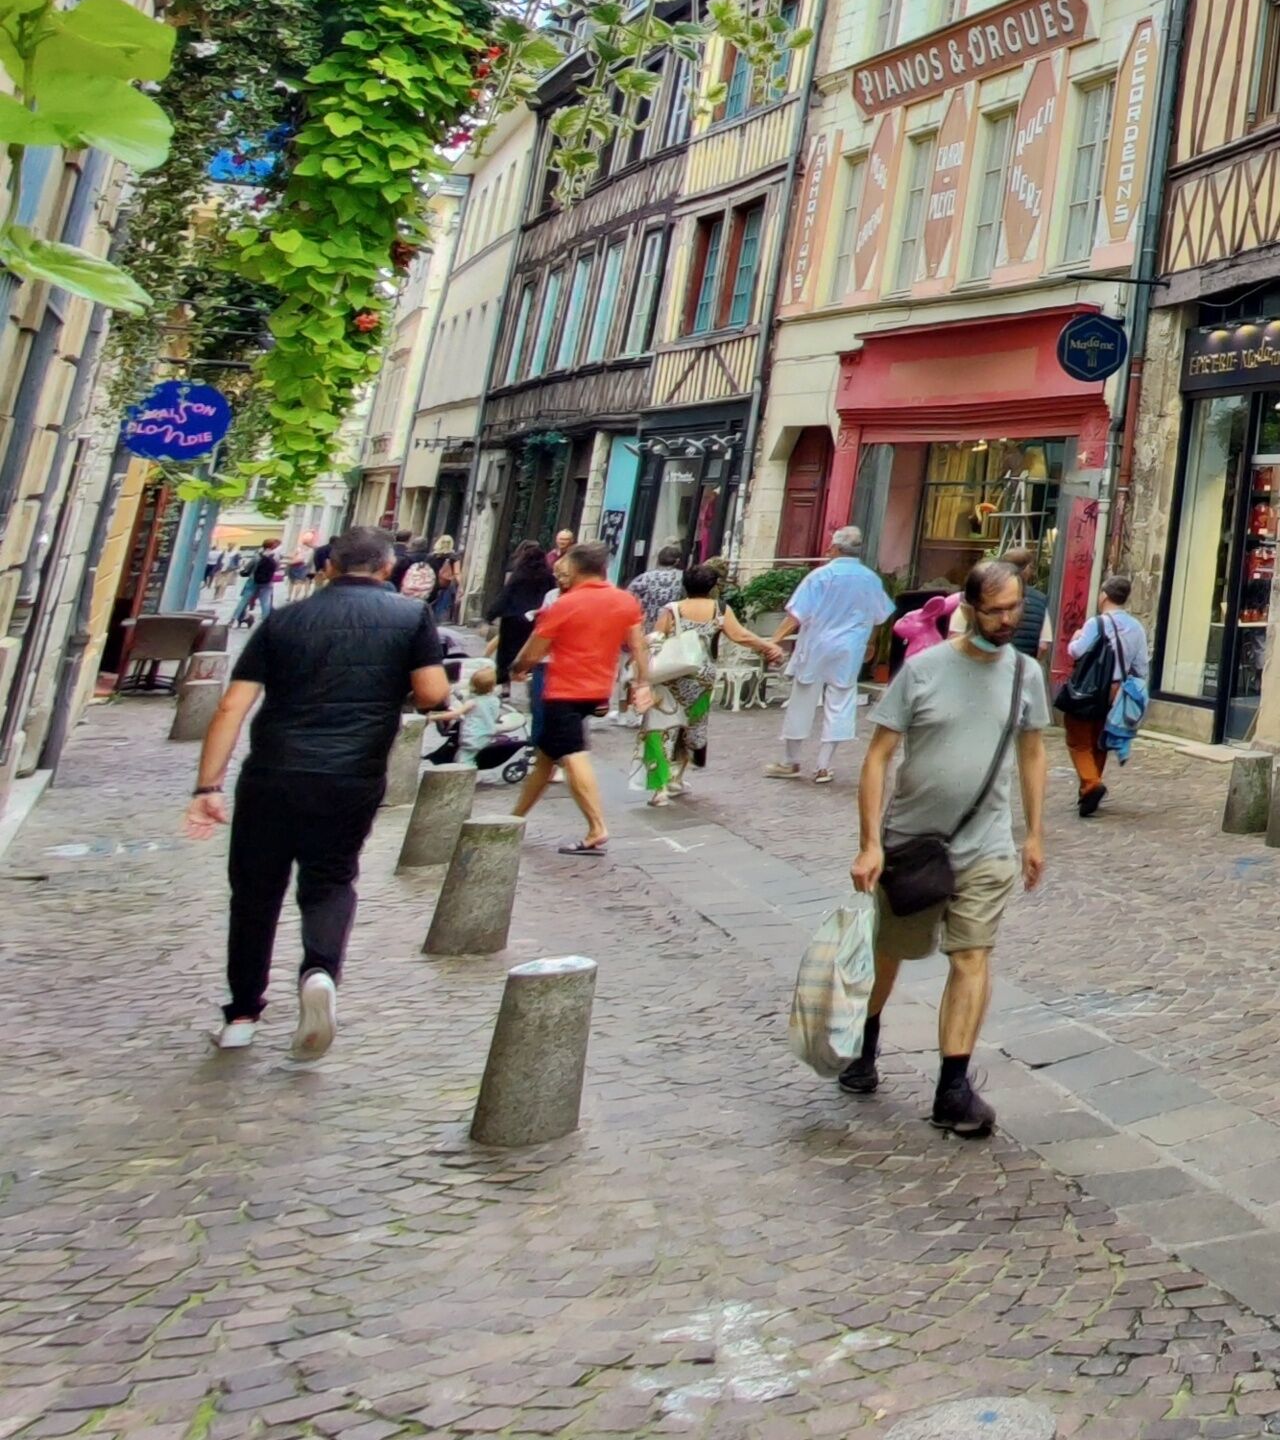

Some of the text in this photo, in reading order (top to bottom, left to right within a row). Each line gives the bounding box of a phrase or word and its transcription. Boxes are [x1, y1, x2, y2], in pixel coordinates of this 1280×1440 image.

[858, 47, 944, 106] PIANOS
[948, 39, 967, 74] &
[928, 190, 957, 220] PLEYEL
[1011, 165, 1042, 218] HERZ
[794, 140, 827, 288] HARMONIUMS
[1070, 335, 1116, 350] Madame
[1189, 350, 1238, 376] ÉPICERIE
